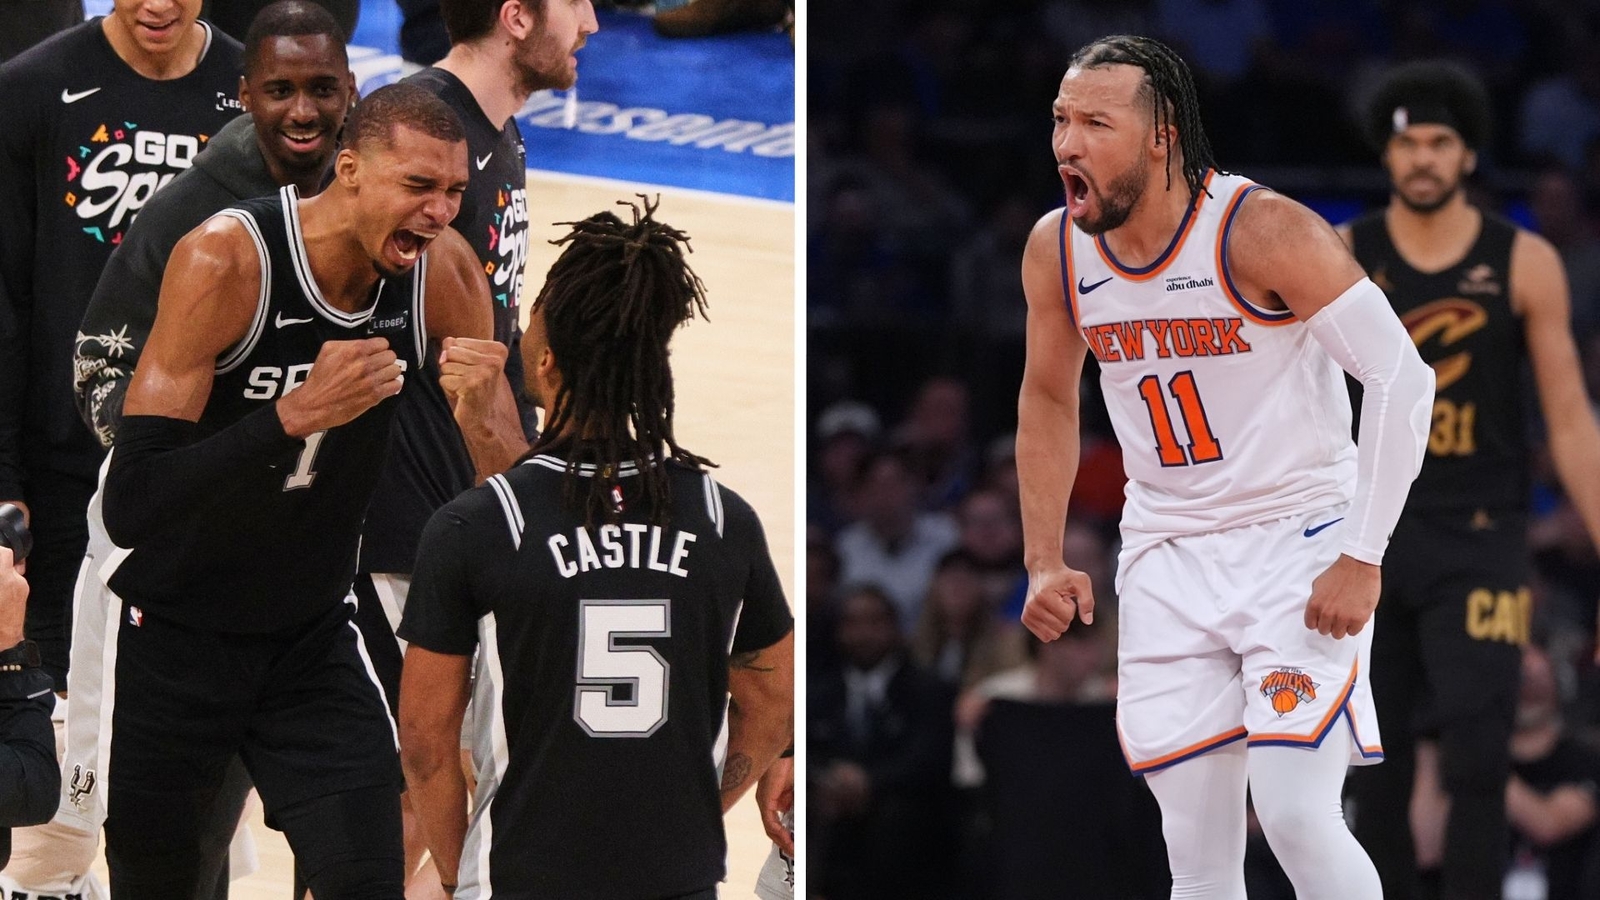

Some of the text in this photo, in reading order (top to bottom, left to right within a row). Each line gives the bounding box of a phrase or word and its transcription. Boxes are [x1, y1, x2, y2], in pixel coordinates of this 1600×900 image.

[222, 98, 247, 112] LED
[134, 130, 199, 169] GO
[1166, 276, 1214, 292] abu dhabi
[373, 316, 404, 329] LEDGER
[1082, 317, 1253, 364] NEW YORK
[1137, 369, 1224, 468] 11
[1428, 399, 1476, 456] 31
[282, 428, 329, 493] 1
[548, 523, 697, 579] CASTLE
[573, 599, 671, 738] 5
[1260, 670, 1317, 704] KNICKS
